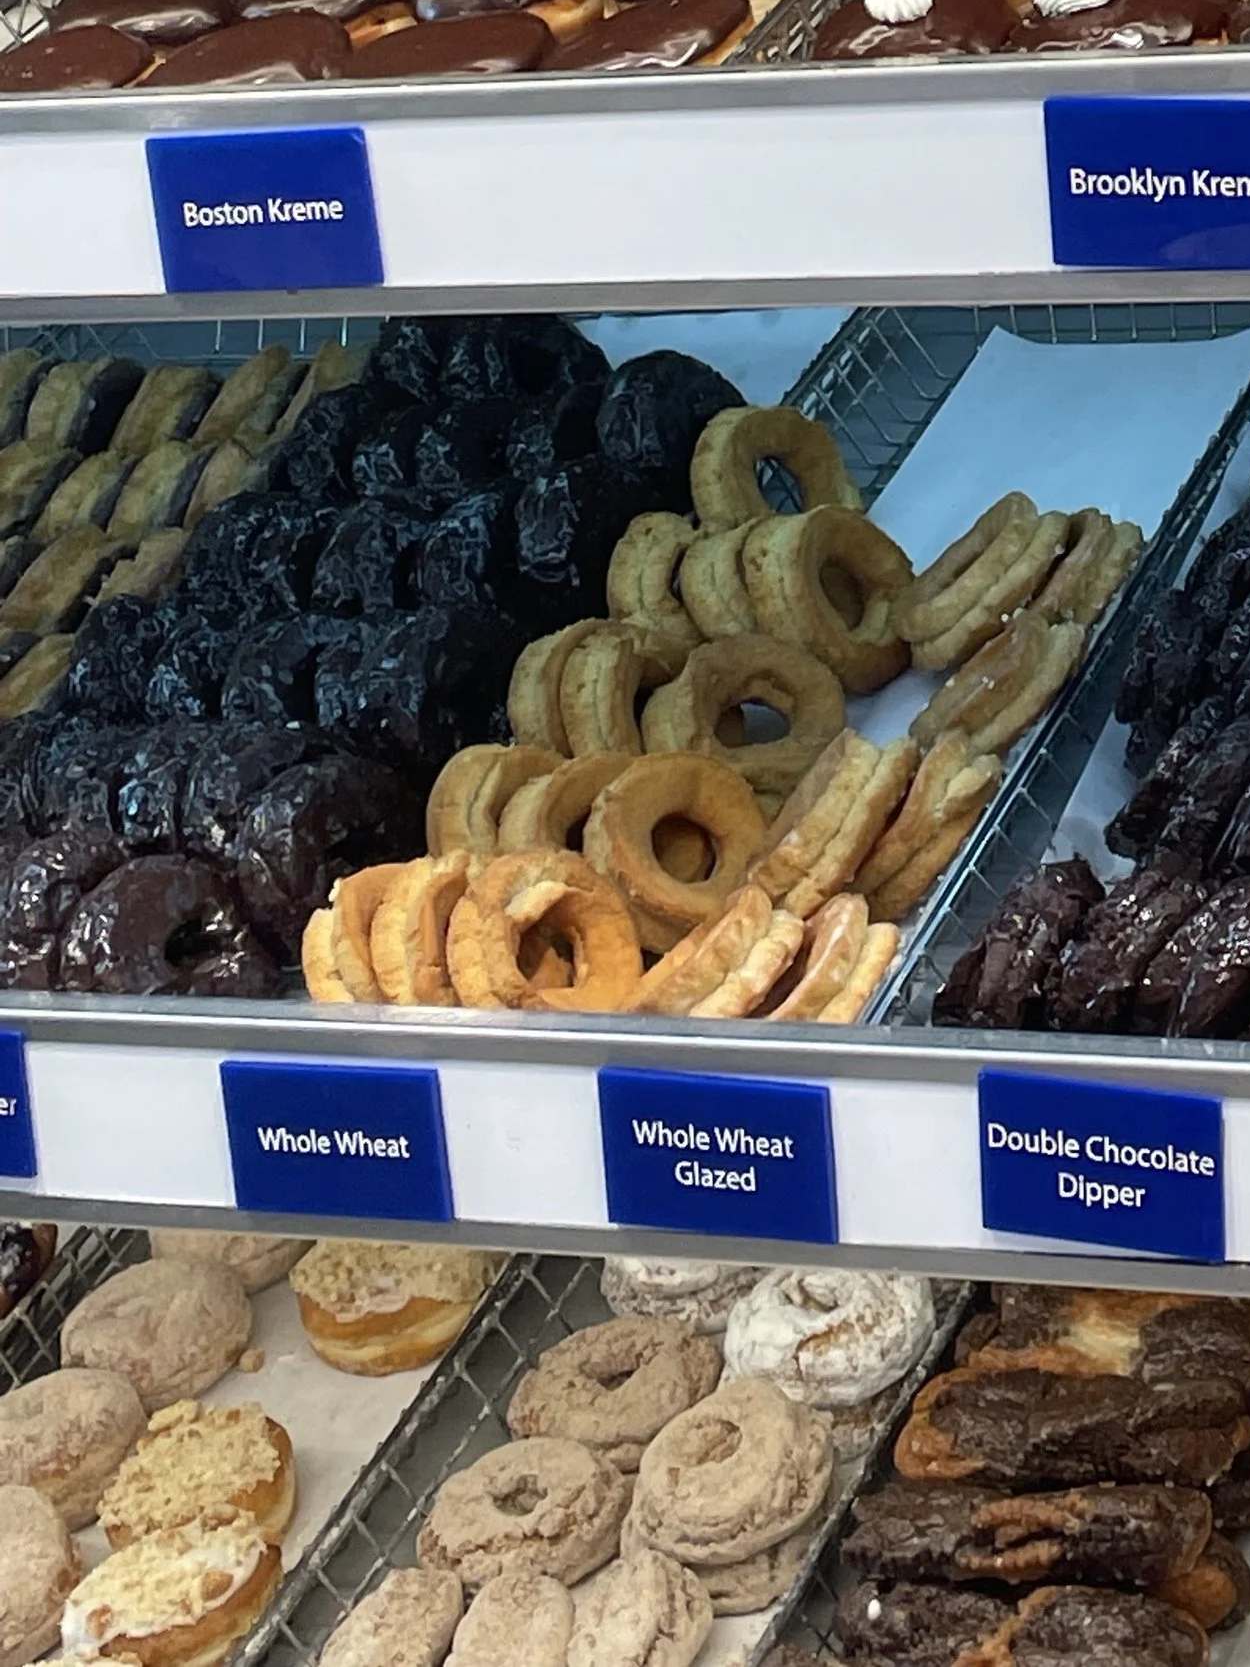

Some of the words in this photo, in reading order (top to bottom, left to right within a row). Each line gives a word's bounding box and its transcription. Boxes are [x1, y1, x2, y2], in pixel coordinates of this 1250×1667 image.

[1069, 167, 1187, 203] Brooklyn
[182, 201, 263, 228] Boston
[267, 197, 344, 223] Kreme
[257, 1126, 331, 1155] Whole
[333, 1130, 411, 1159] Wheat
[631, 1119, 711, 1151] Whole
[713, 1126, 794, 1159] Wheat
[987, 1122, 1080, 1159] Double
[1085, 1135, 1215, 1177] Chocolate
[674, 1160, 756, 1192] Glazed
[1058, 1172, 1146, 1210] Dipper
